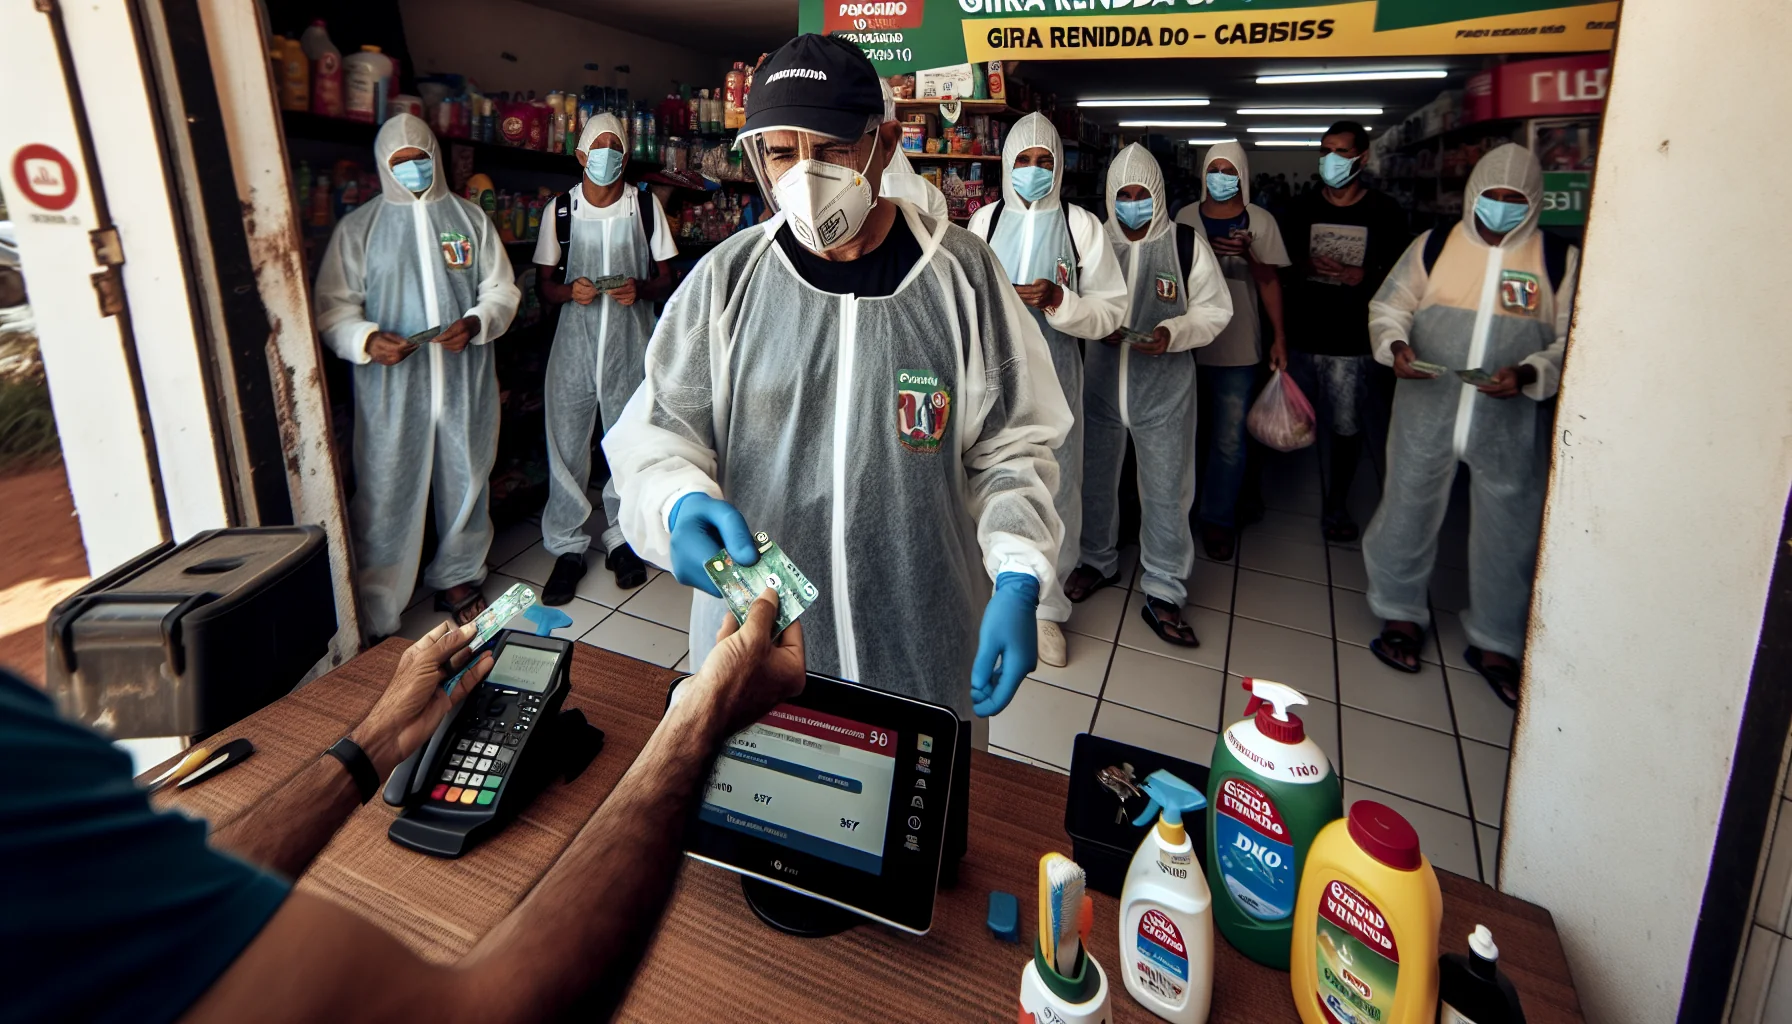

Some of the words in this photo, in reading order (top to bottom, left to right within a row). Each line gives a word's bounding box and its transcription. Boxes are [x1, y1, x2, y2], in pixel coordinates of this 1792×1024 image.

[987, 27, 1043, 48] GIRA
[1050, 26, 1154, 48] RENIDDA
[1159, 27, 1189, 46] DO
